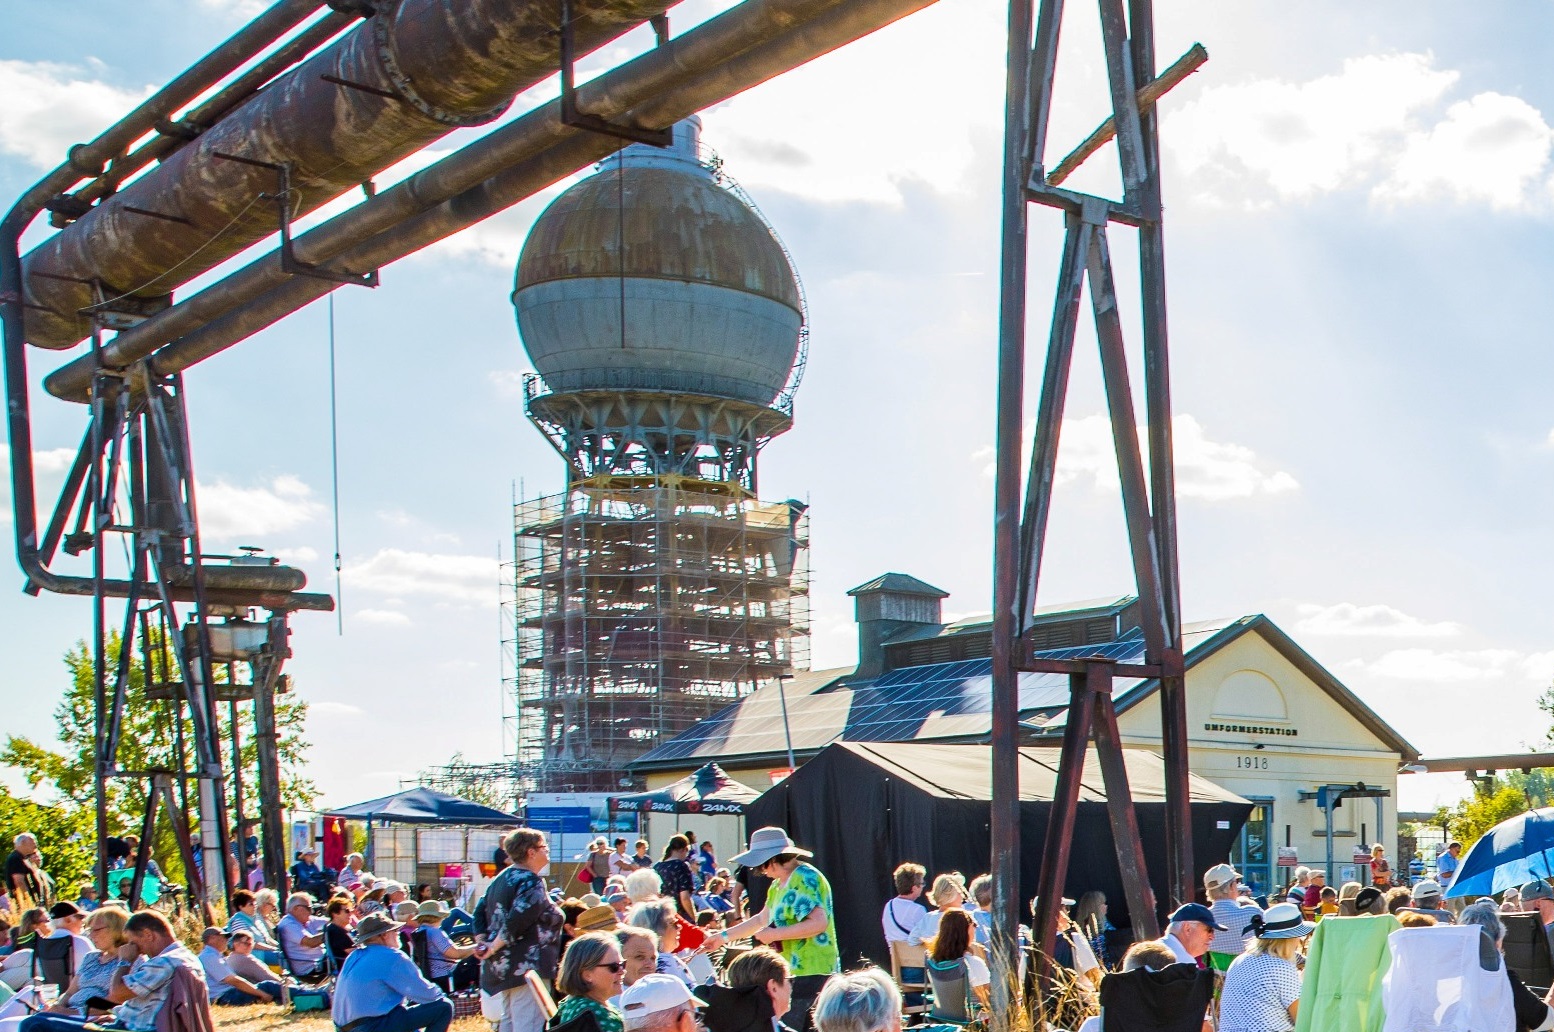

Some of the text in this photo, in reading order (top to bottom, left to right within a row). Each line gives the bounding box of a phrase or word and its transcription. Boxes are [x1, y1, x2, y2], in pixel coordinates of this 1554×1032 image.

[1204, 723, 1298, 736] UMFORMERSTATION
[1237, 756, 1269, 770] 1918
[702, 803, 742, 813] 24MX
